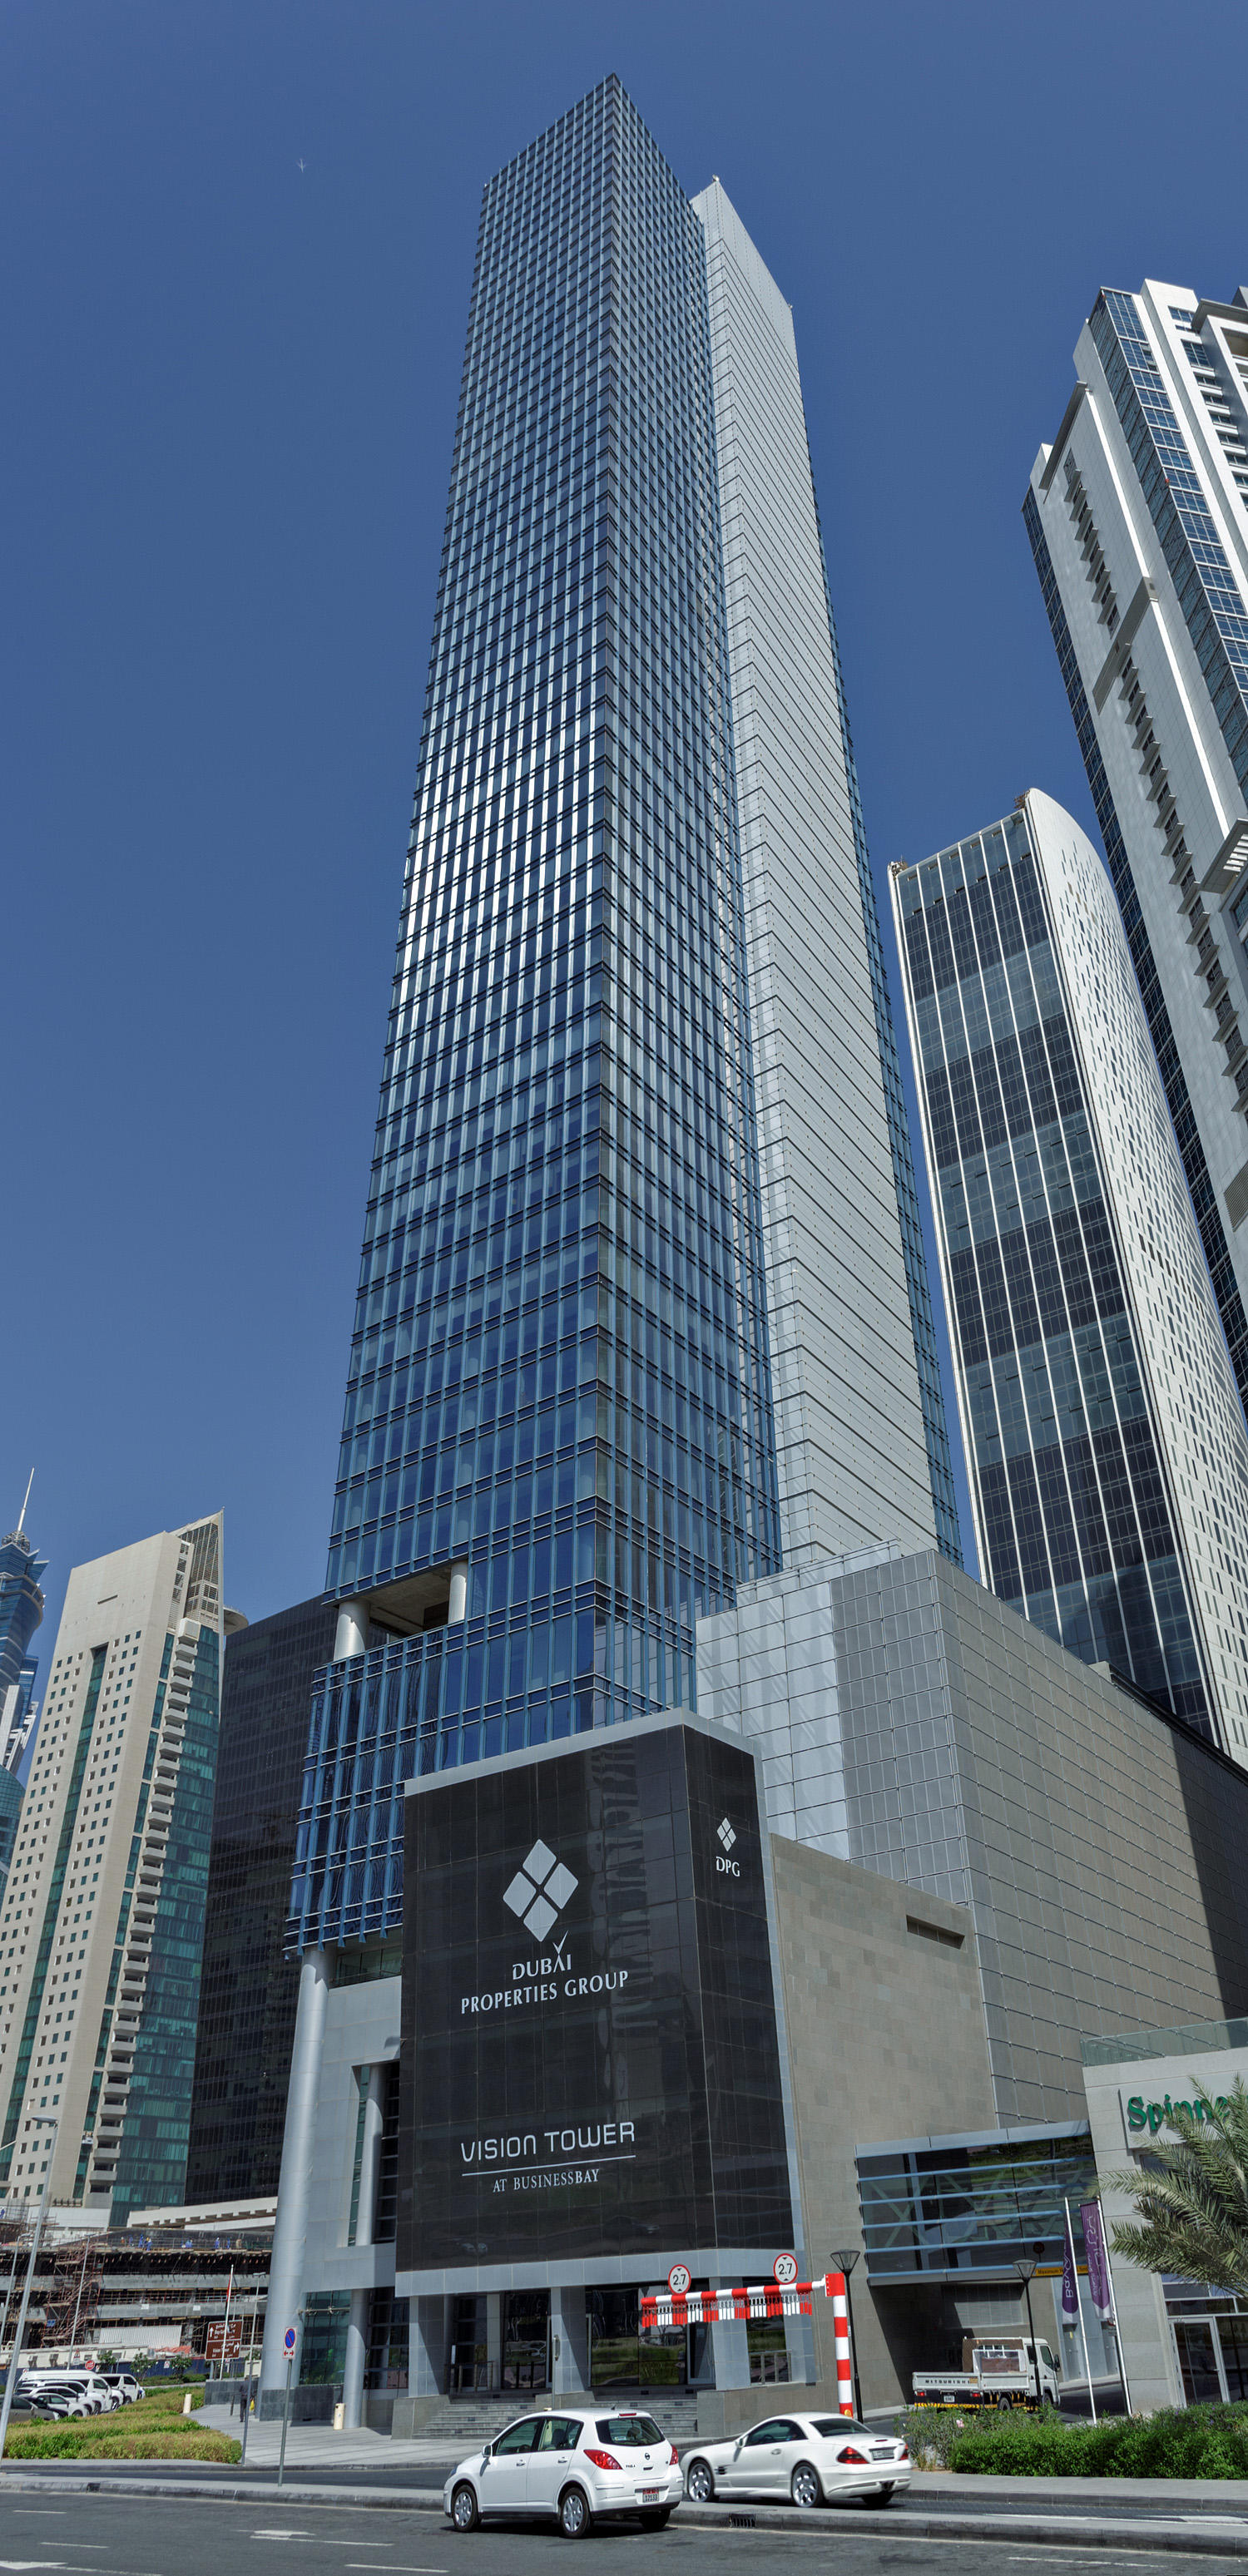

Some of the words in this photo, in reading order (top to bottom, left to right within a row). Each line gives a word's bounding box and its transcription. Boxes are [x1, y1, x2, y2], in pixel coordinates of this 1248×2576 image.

[716, 1856, 740, 1877] DPG
[513, 1942, 572, 1980] DUBAI
[461, 1982, 557, 2015] PROPERTIES
[564, 1970, 629, 1997] GROUP
[461, 2134, 537, 2163] VISION
[544, 2121, 635, 2153] TOWER
[493, 2178, 508, 2193] AT
[513, 2168, 600, 2191] BUSINESSBAY
[672, 2274, 686, 2286] 2.7
[778, 2263, 793, 2275] 2.7
